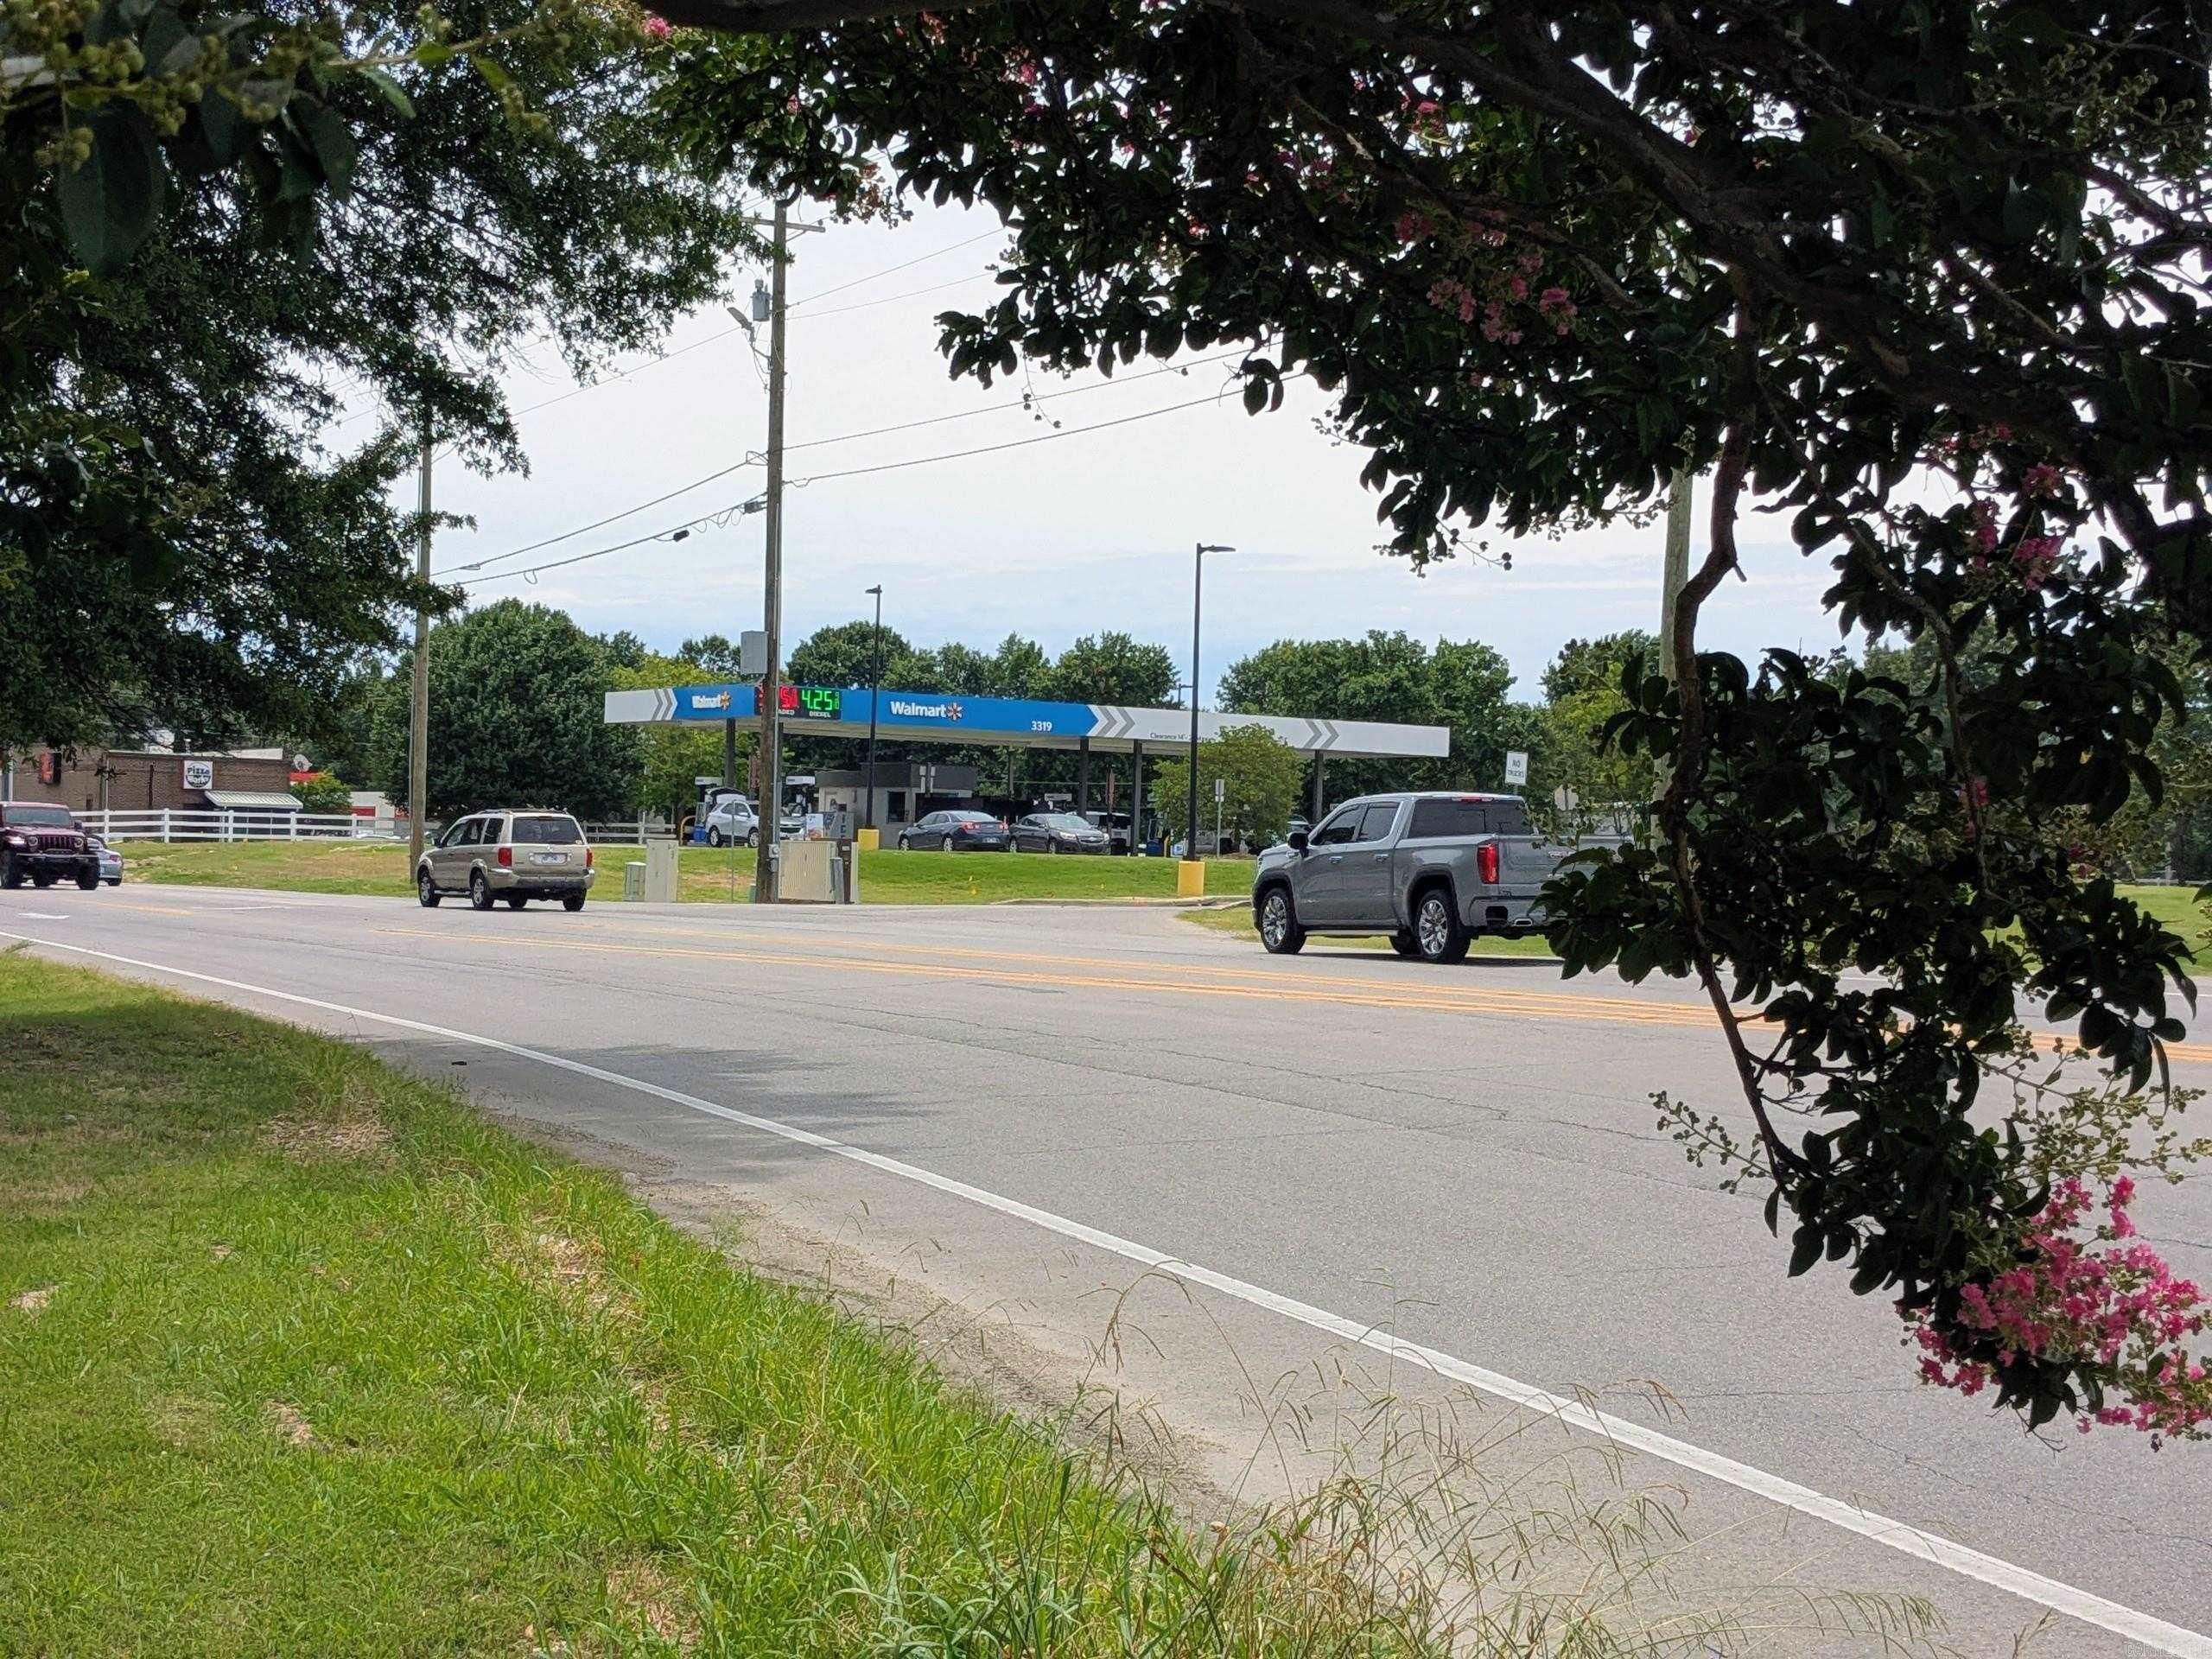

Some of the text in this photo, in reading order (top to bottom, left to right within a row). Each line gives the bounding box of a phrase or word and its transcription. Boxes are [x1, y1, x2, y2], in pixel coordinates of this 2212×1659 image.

[691, 695, 721, 708] Walmart
[890, 701, 946, 718] Walmart
[1031, 721, 1052, 732] 3319
[1512, 760, 1521, 768] NO
